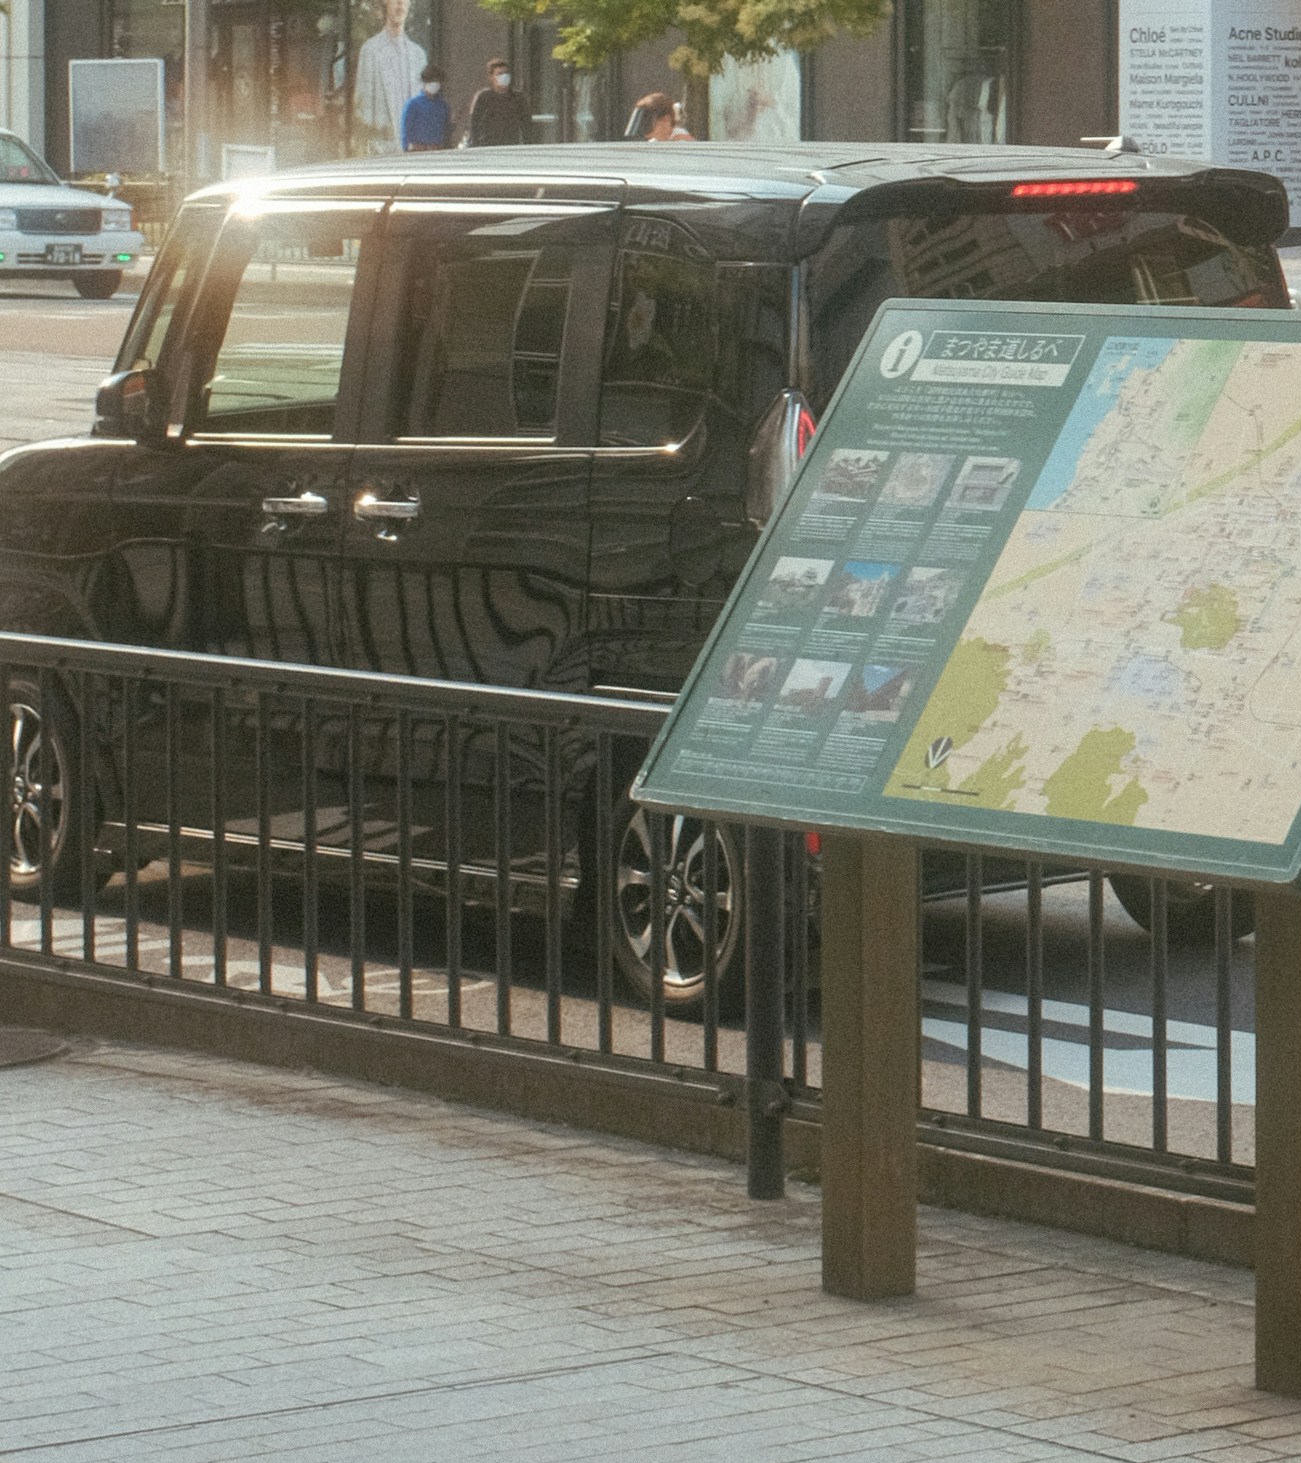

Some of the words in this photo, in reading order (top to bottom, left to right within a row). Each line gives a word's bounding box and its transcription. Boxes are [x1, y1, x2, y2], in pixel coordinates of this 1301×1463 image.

[1129, 25, 1166, 44] Chloé
[1228, 26, 1262, 41] Acne
[1130, 73, 1162, 85] Maison
[1164, 73, 1203, 87] Margiela
[941, 337, 1064, 361] まつやま道しるべ
